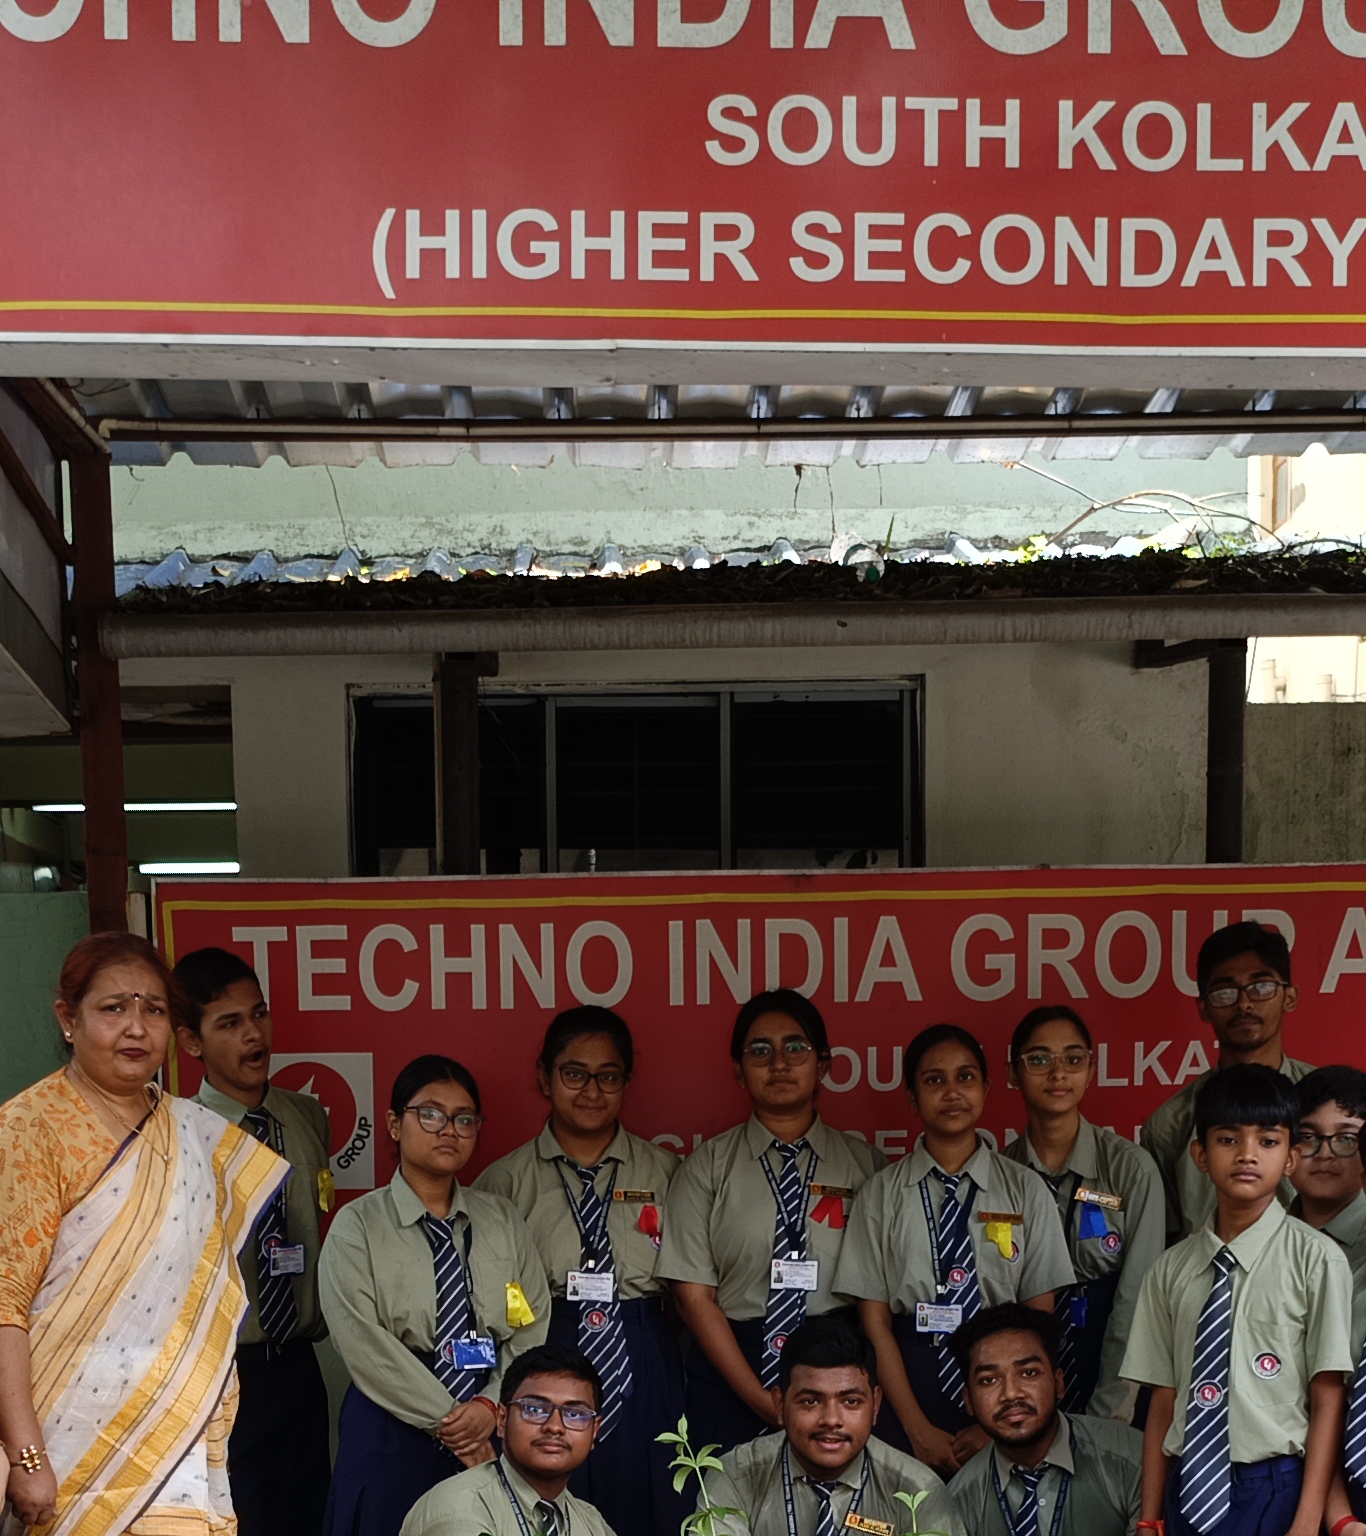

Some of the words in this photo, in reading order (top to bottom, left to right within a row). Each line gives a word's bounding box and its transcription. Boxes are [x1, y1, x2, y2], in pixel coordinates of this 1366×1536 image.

[705, 93, 1020, 168] SOUTH
[372, 207, 760, 299] (HIGHER
[231, 919, 634, 1012] TECHNO
[668, 915, 924, 1006] INDIA
[336, 1116, 373, 1170] GROUP
